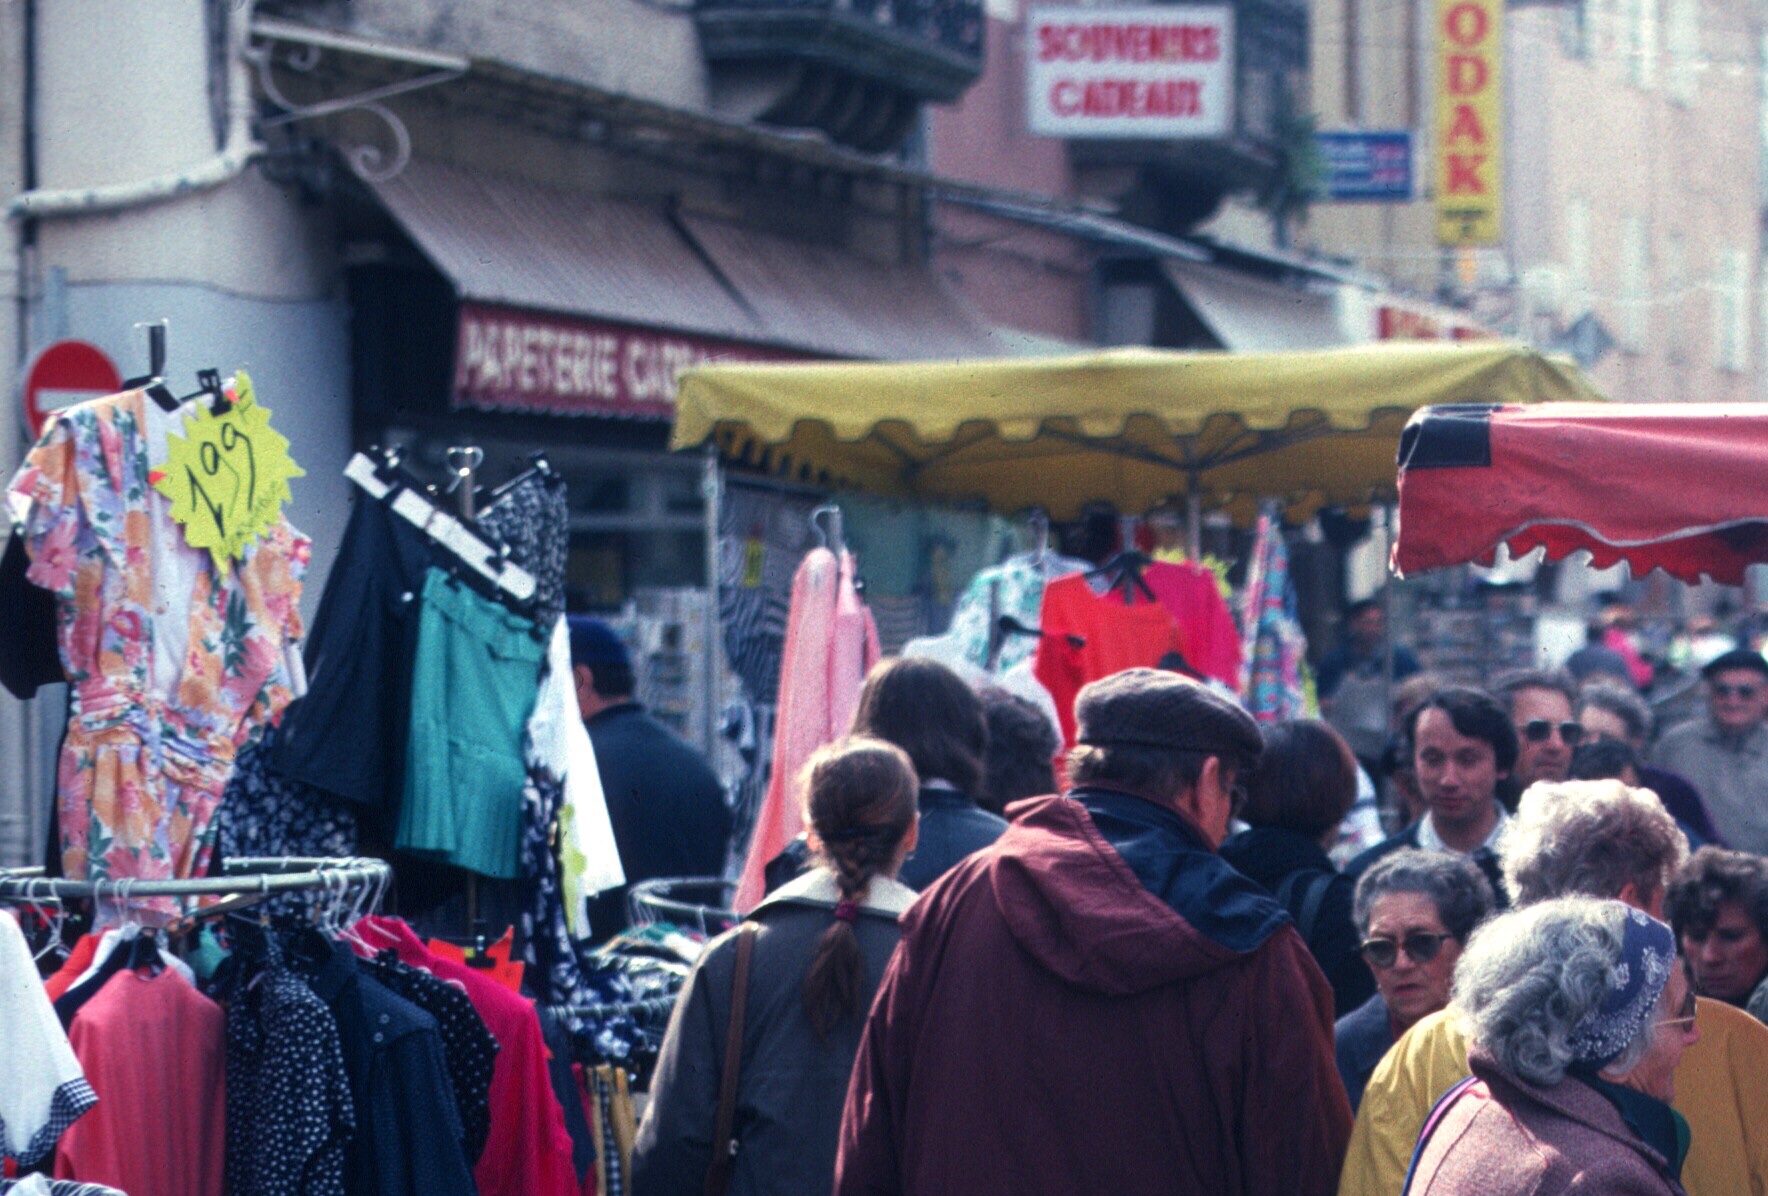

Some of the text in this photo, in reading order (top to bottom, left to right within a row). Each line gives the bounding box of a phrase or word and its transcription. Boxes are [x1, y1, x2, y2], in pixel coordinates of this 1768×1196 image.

[1038, 24, 1220, 62] SOUVENIRS
[1049, 80, 1202, 117] CADEAUX
[1445, 3, 1488, 194] ODAK
[462, 320, 618, 398] PAPETERIE
[185, 422, 256, 539] 199
